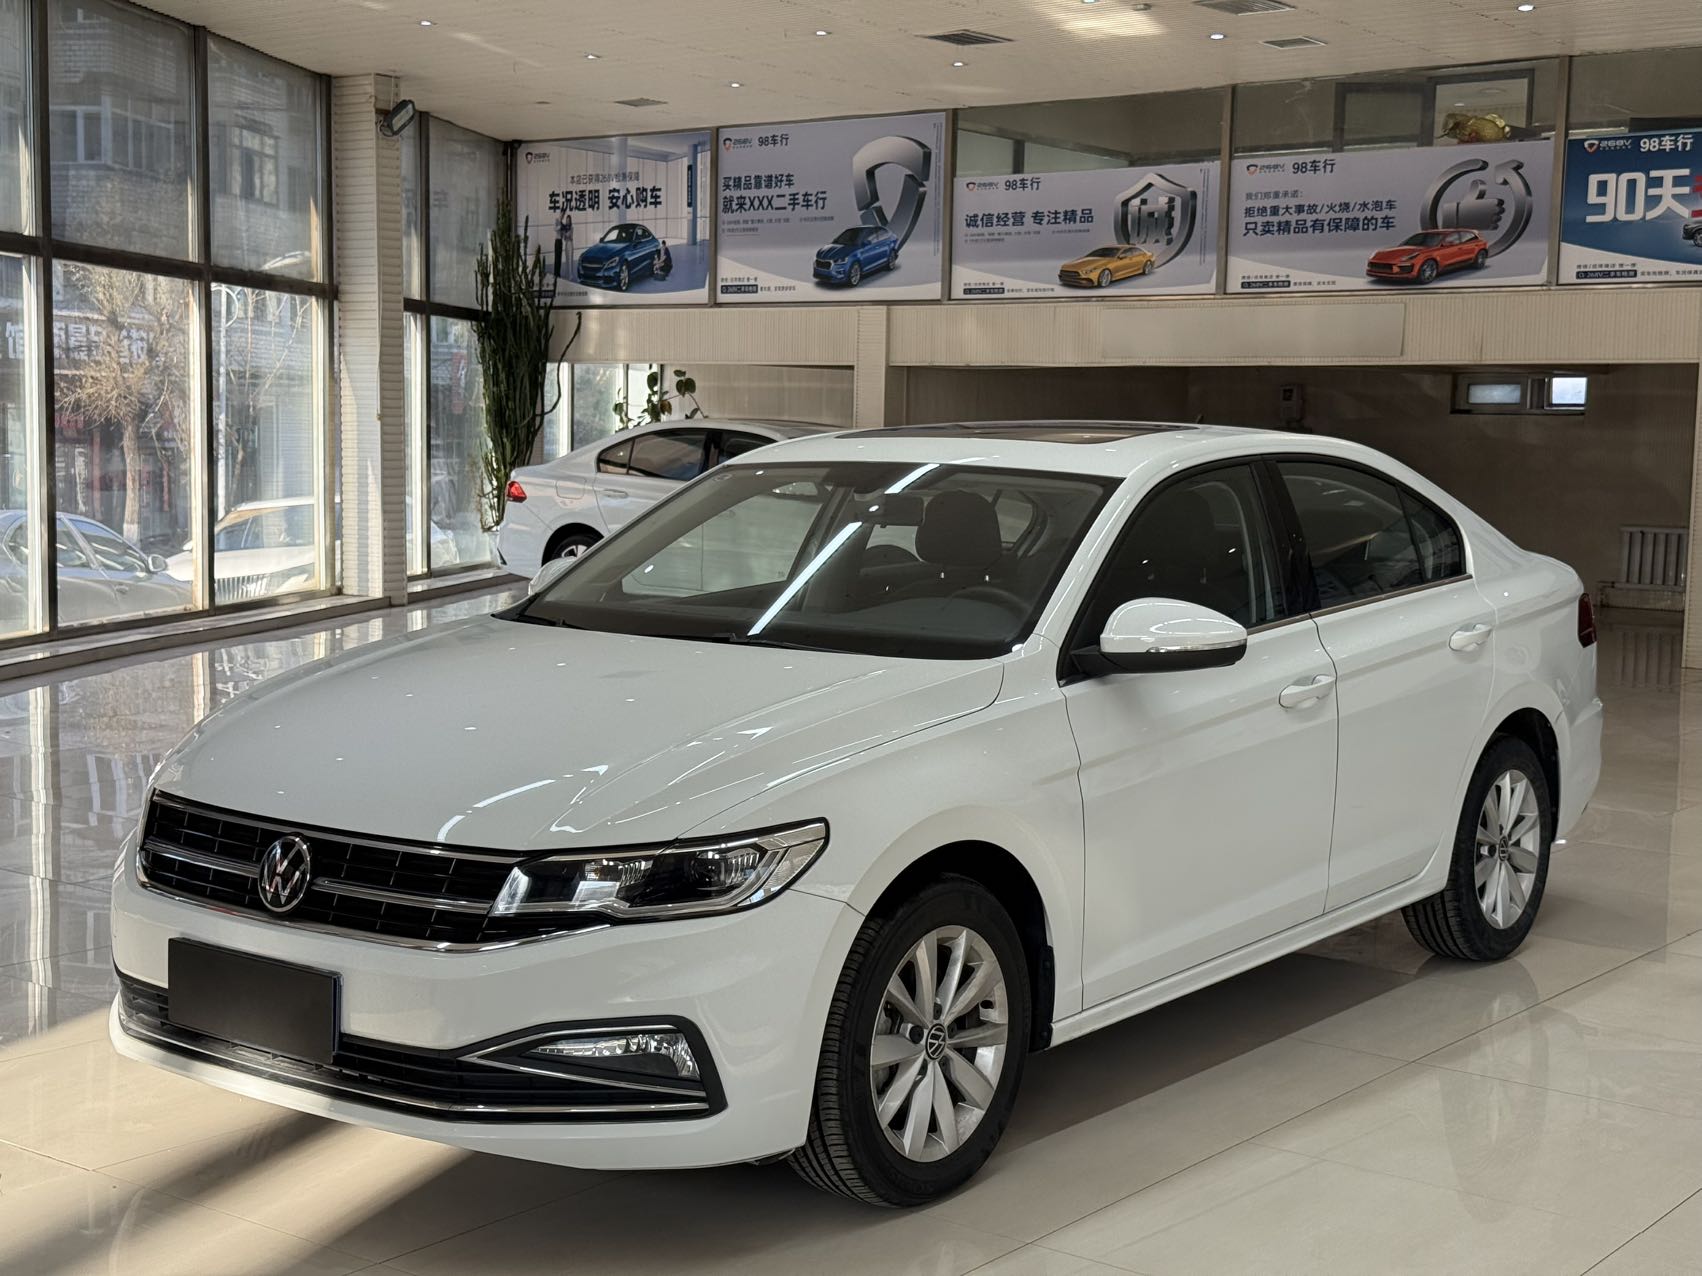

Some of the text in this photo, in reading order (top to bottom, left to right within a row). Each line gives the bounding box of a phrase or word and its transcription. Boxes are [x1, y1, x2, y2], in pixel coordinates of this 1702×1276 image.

[758, 134, 790, 147] 98车行
[1640, 134, 1694, 153] 98车行
[1292, 159, 1336, 174] 98车行
[722, 173, 795, 192] 买精品靠谱好车
[1005, 177, 1041, 191] 98车行
[548, 189, 600, 213] 车况透明
[608, 186, 662, 211] 安心购车
[722, 191, 827, 214] 就来XXX二手车行
[1585, 168, 1691, 223] 90天
[965, 208, 1095, 229] 诚信经营 专注精品
[1244, 199, 1397, 219] 拒绝重大事故/火烧/水泡车
[1243, 215, 1397, 237] 只卖精品有保障的车
